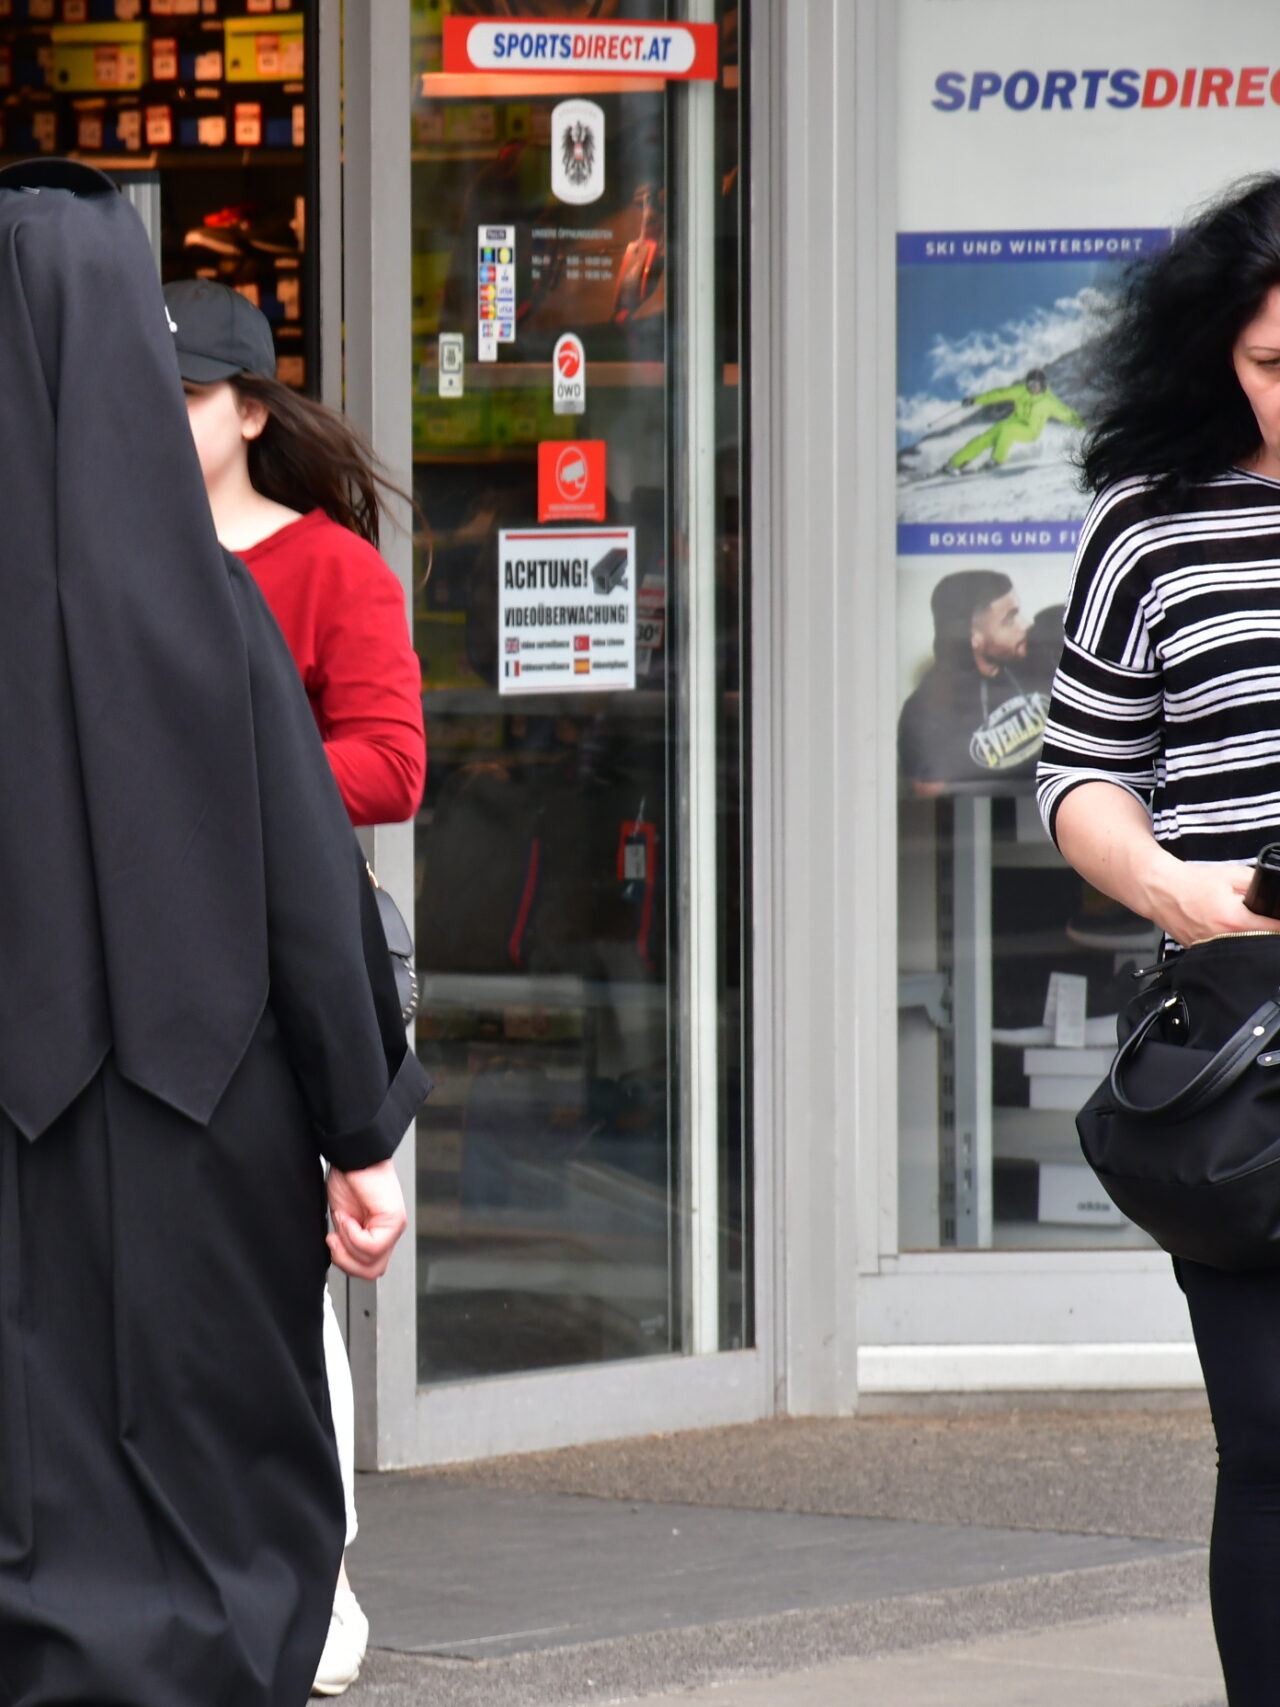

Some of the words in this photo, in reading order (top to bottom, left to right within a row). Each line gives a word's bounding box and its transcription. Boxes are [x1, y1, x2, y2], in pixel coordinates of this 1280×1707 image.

[493, 33, 672, 61] SPORTSDIRECT.AT
[925, 242, 955, 256] SKI
[962, 241, 1002, 255] UND
[1009, 238, 1143, 254] WINTERSPORT
[929, 531, 1004, 547] BOXING
[1011, 531, 1051, 545] UND
[1059, 530, 1083, 545] FI
[504, 558, 589, 590] ACHTUNG!
[504, 602, 629, 628] VIDEOÜBERWACHUNG!
[972, 691, 1049, 769] EVERLAST
